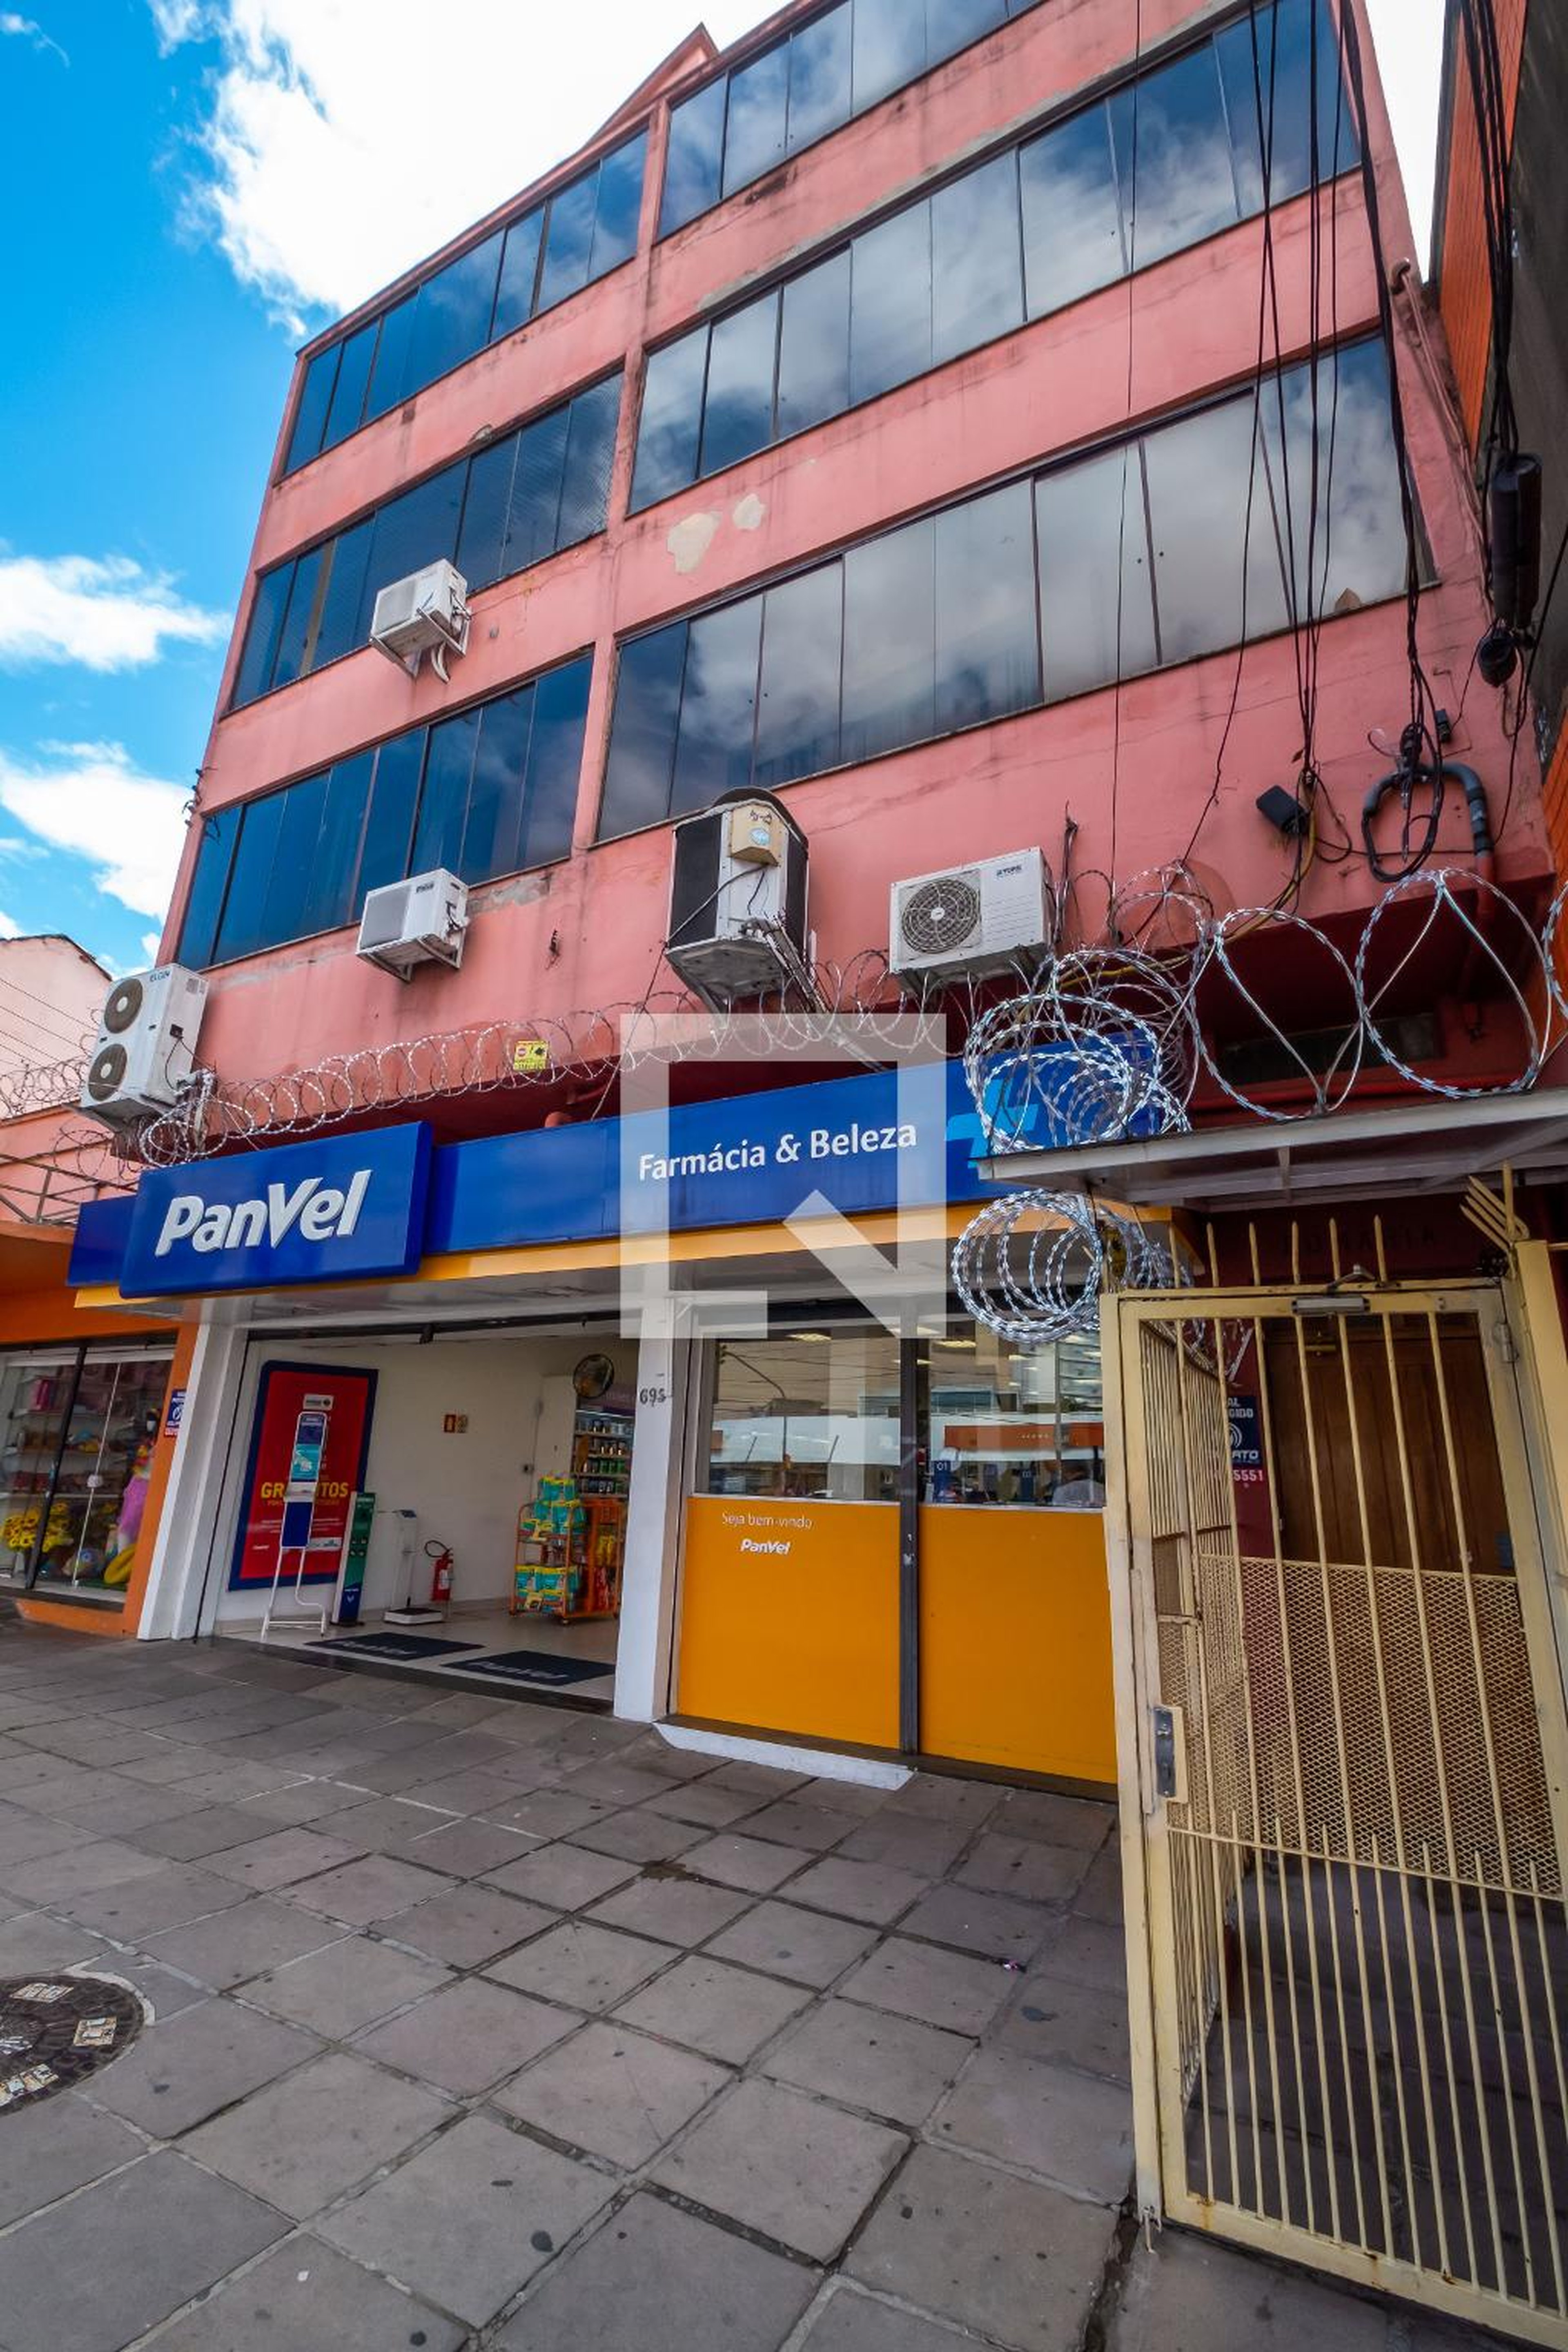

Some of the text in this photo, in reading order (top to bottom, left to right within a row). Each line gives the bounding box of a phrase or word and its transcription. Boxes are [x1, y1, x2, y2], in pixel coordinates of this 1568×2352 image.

[639, 1123, 917, 1181] Farmácia & Beleza
